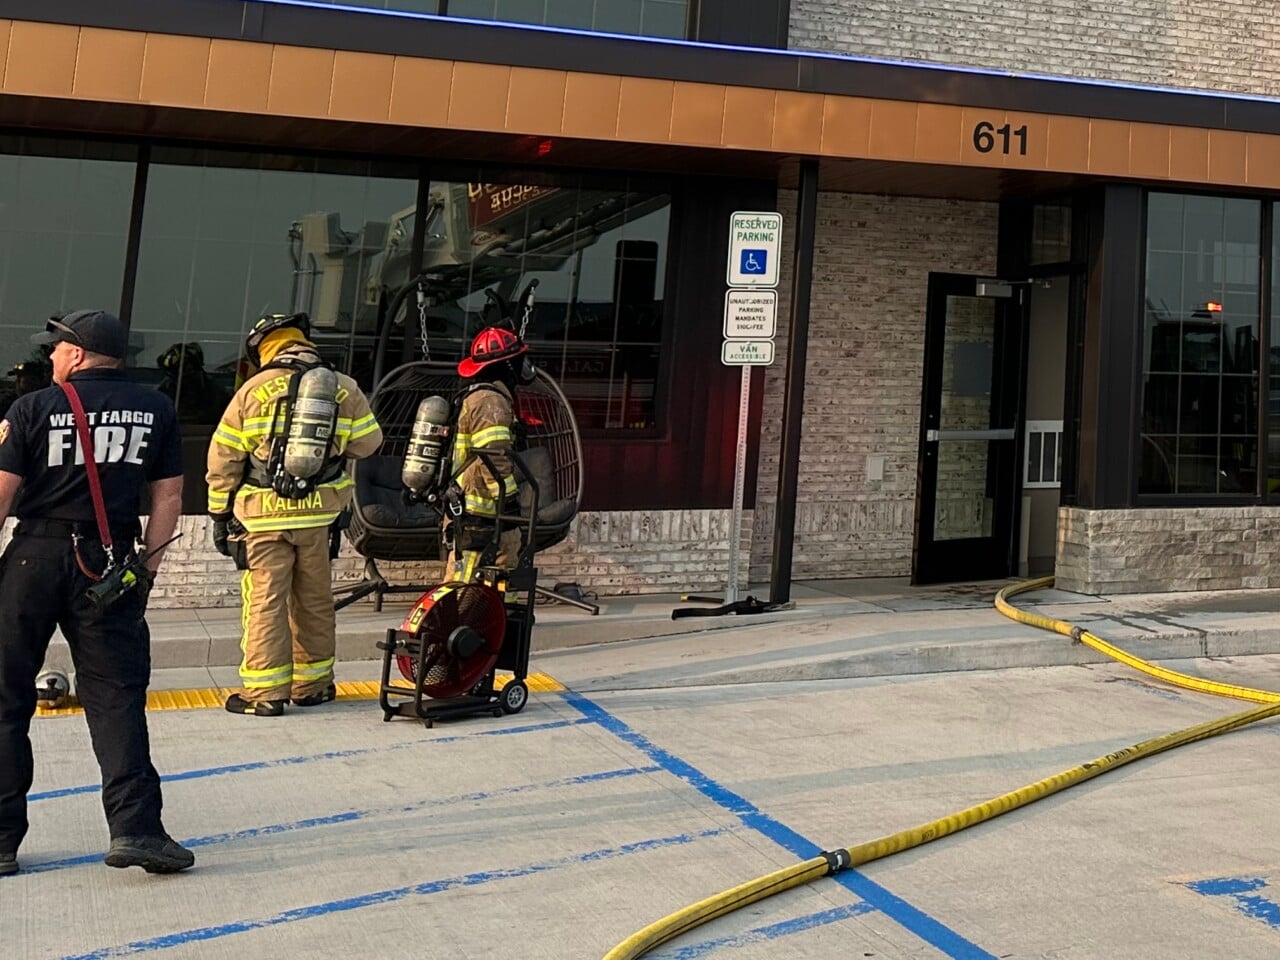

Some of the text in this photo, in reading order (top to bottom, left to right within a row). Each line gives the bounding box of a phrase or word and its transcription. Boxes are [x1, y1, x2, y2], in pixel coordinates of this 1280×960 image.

[973, 121, 1027, 156] 611
[735, 219, 778, 230] RESERVED
[737, 231, 774, 242] PARKING
[739, 345, 758, 353] VAN
[50, 410, 154, 427] WET FARGO
[261, 490, 323, 513] KALINA
